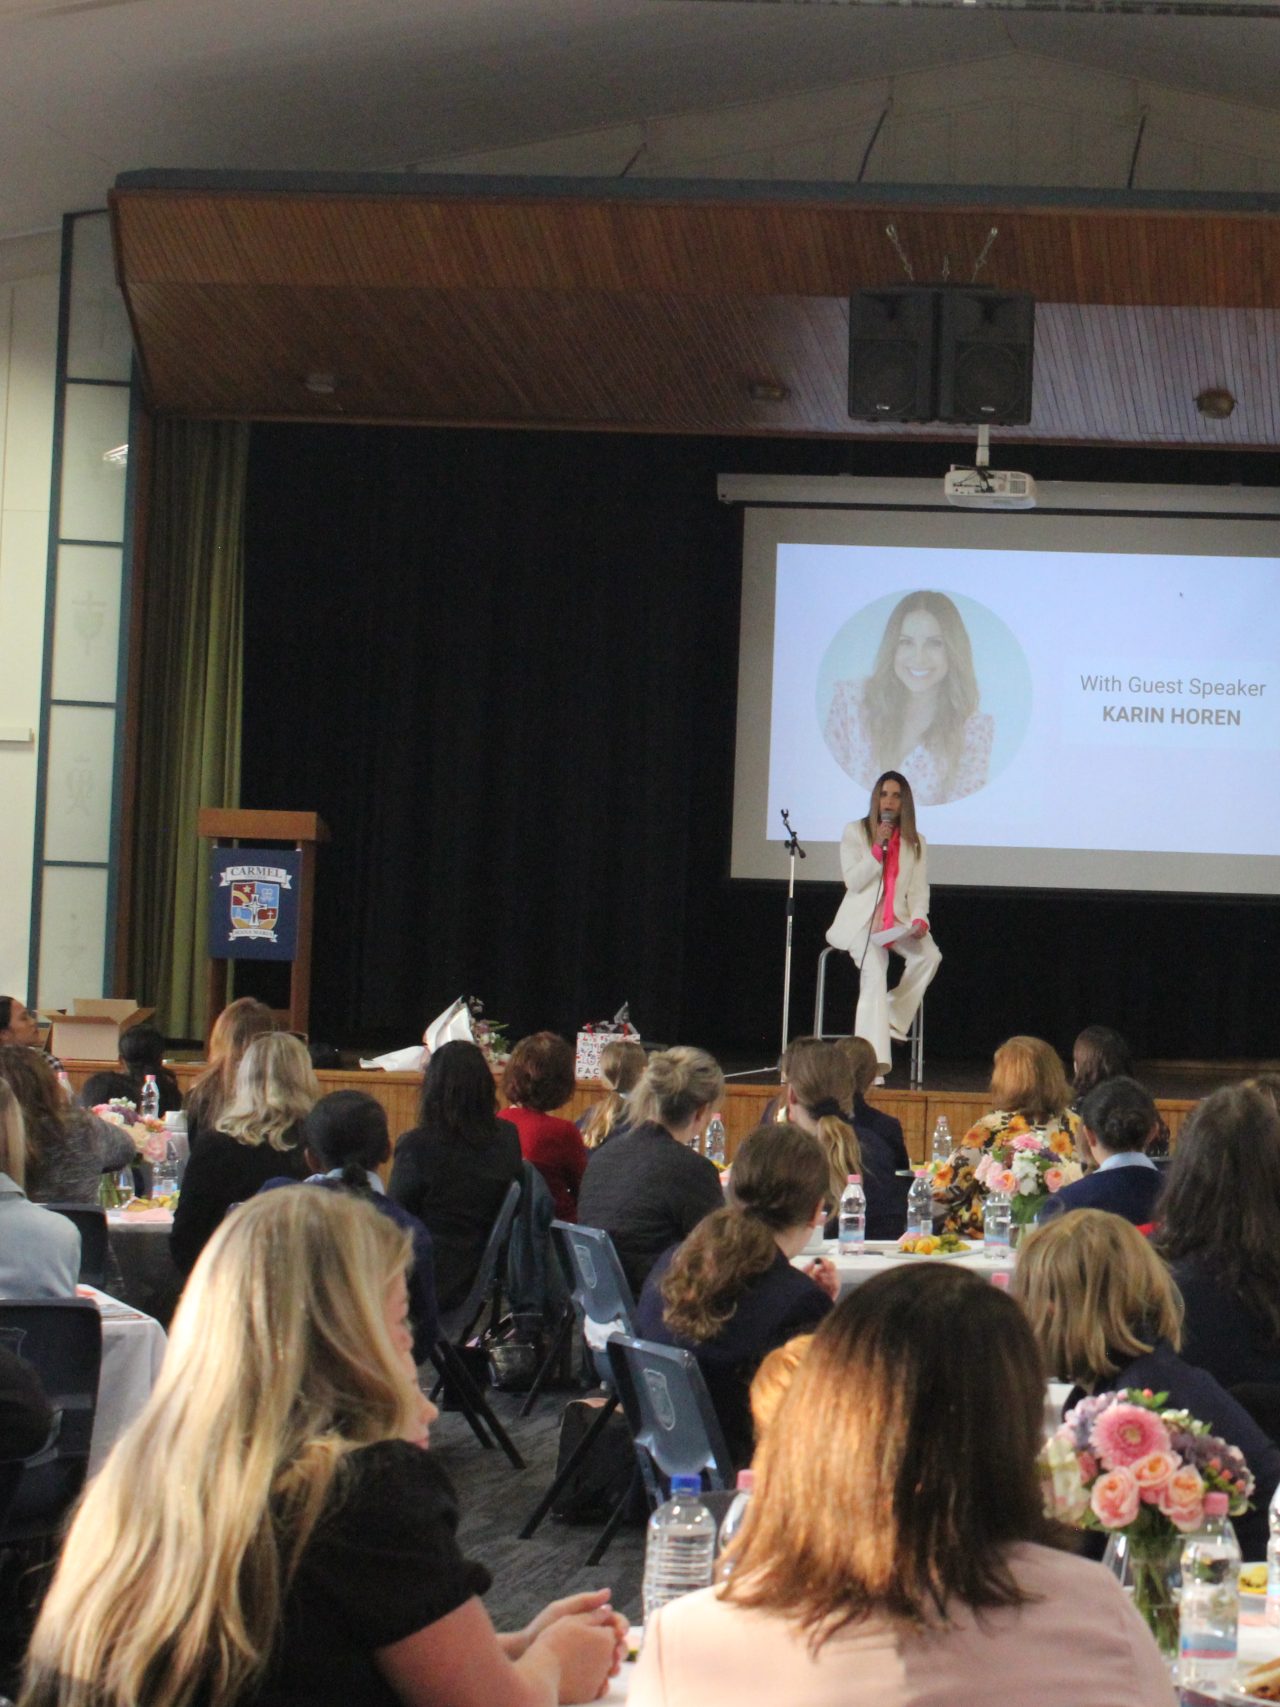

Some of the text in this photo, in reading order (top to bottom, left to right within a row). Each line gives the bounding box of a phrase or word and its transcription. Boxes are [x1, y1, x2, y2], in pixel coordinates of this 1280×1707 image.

[1080, 674, 1267, 699] With Guest Speaker
[1102, 706, 1241, 726] KARIN HOREN
[230, 866, 282, 878] CARMEL
